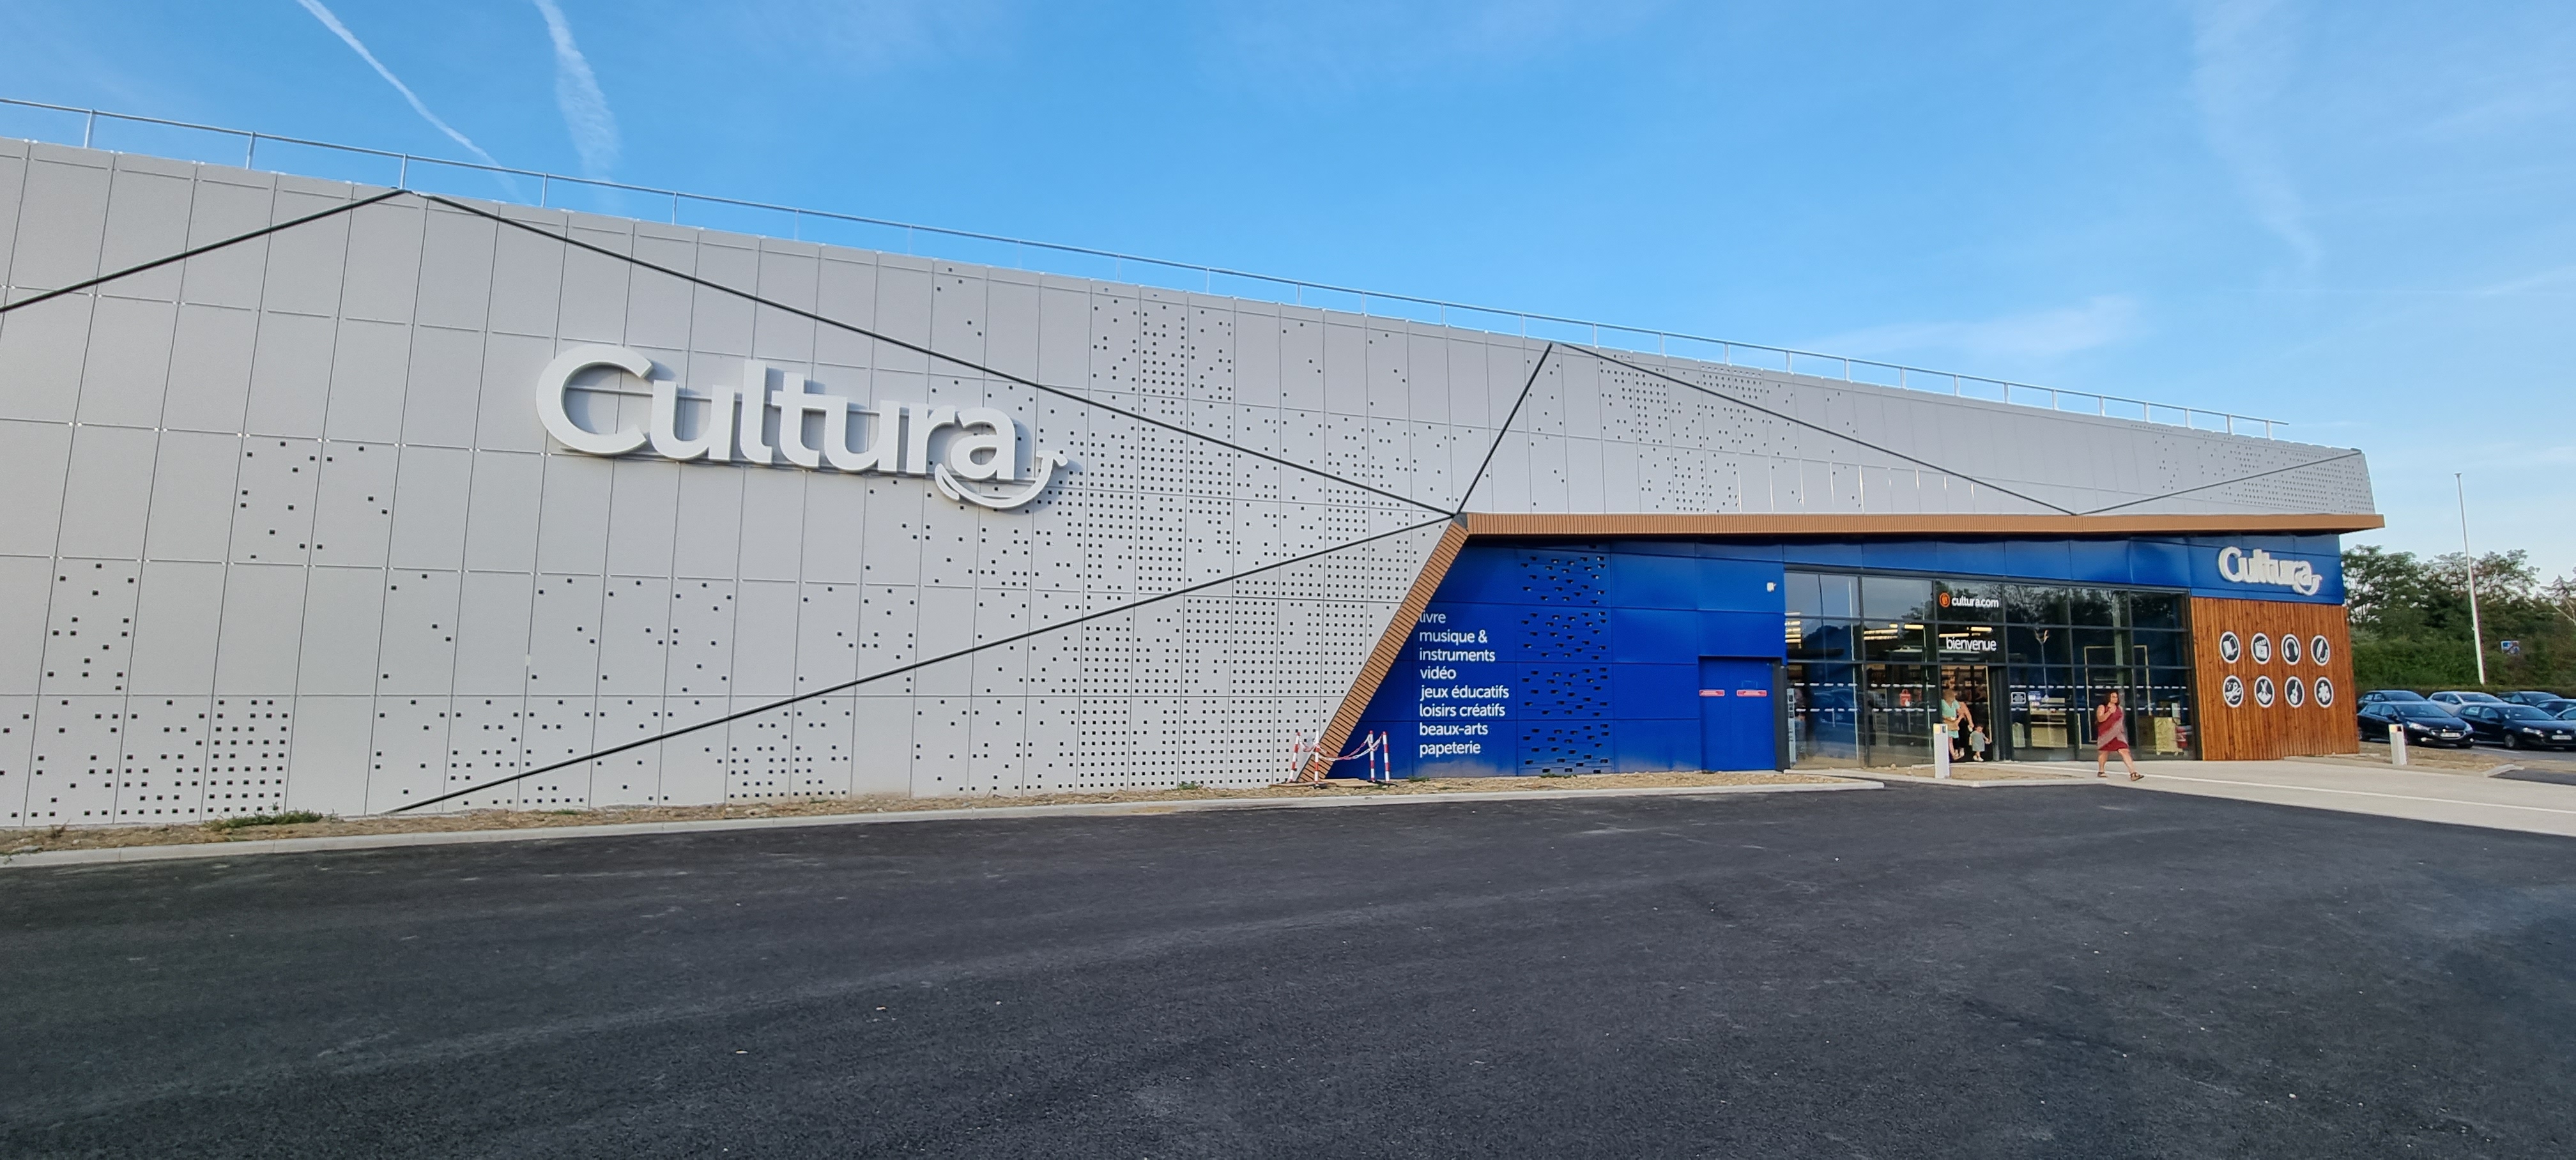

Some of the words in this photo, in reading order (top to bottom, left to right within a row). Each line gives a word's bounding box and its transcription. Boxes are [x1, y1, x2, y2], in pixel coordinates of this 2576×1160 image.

[535, 344, 1016, 481] Cultura
[2218, 546, 2312, 586] Cultura
[1952, 595, 1999, 608] cultura.com
[1420, 630, 1475, 645] musique
[1478, 630, 1487, 643] &
[1946, 636, 1997, 652] bienvenue
[1420, 648, 1496, 662] instruments
[1420, 666, 1457, 680] vidéo
[1420, 685, 1448, 701] jeux
[1452, 685, 1509, 698] éducatifs
[1420, 703, 1457, 717] loisirs
[1459, 703, 1505, 717] créatifs
[1420, 722, 1488, 735] beaux-arts
[1420, 740, 1480, 758] papeterie
